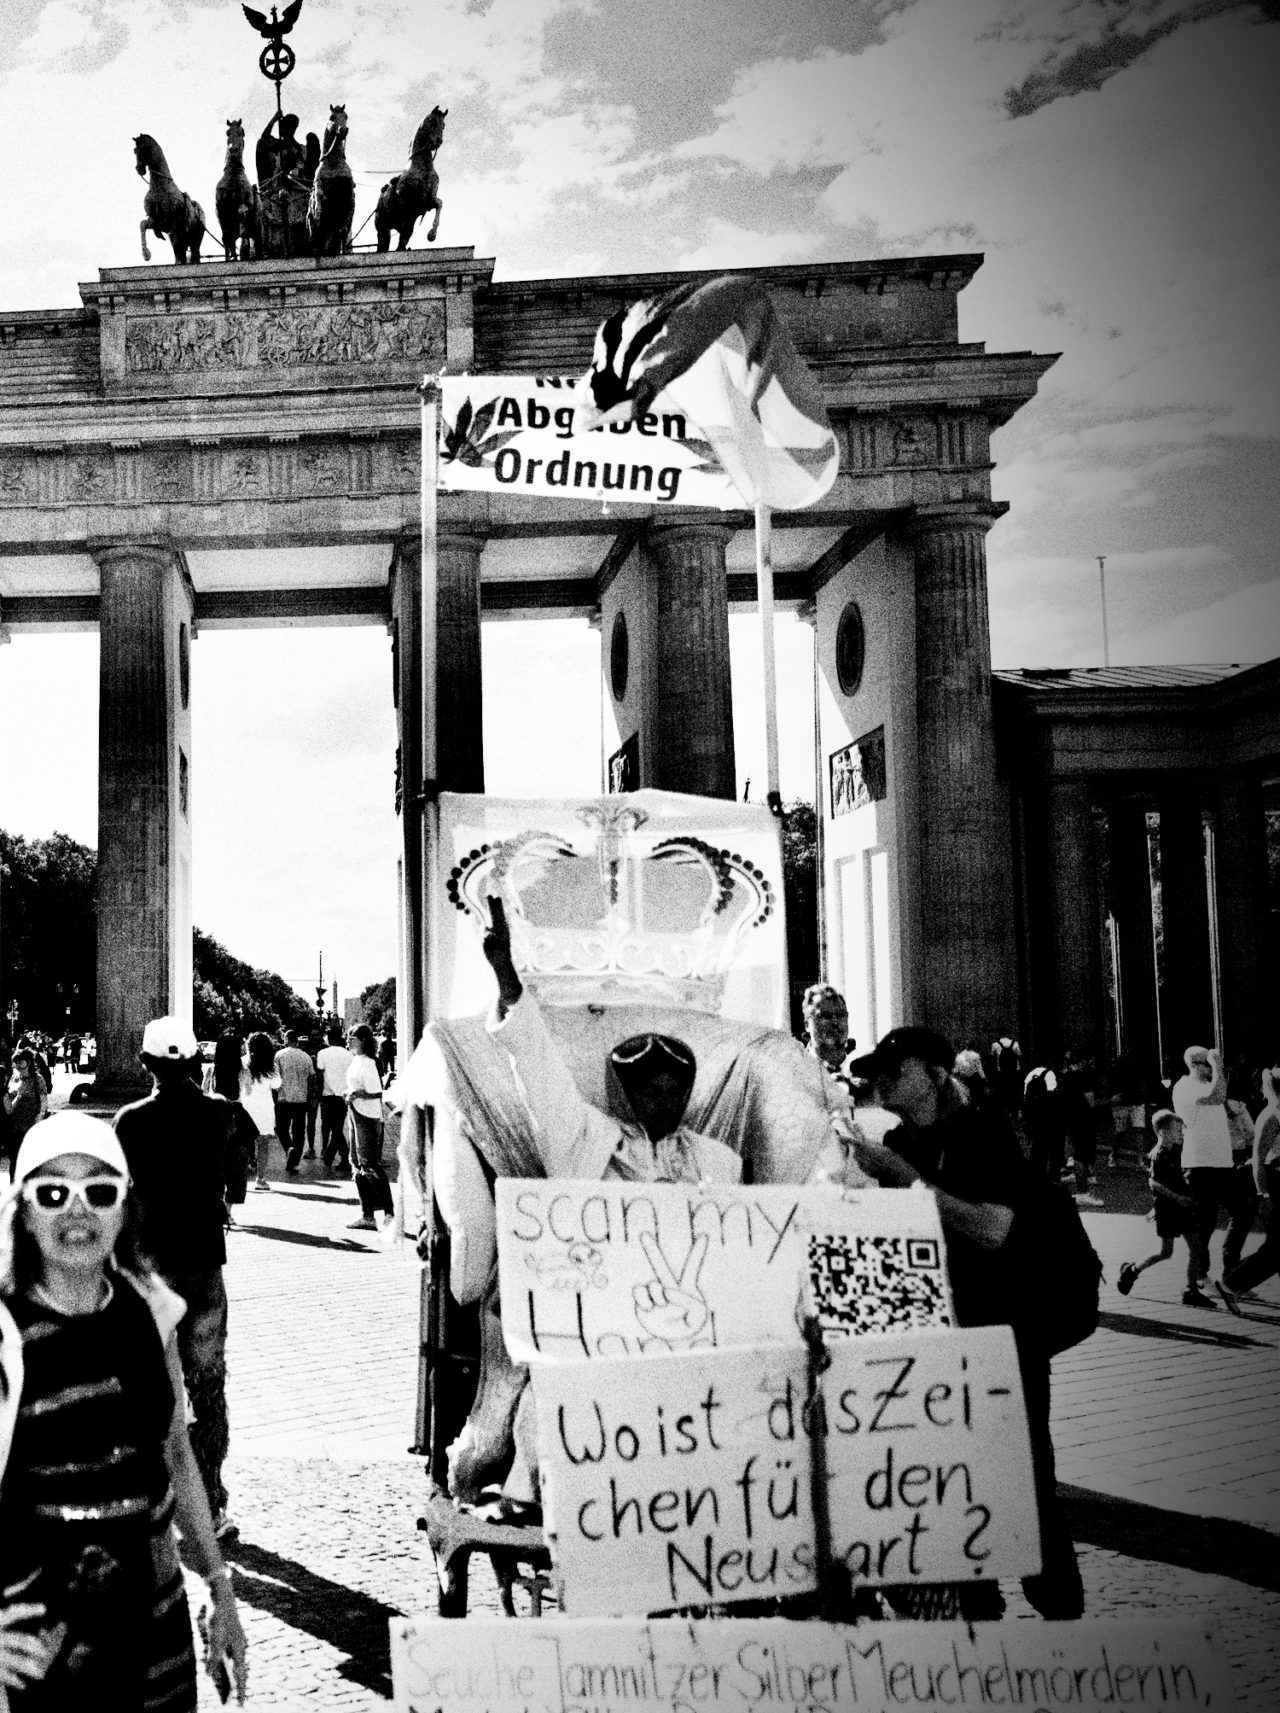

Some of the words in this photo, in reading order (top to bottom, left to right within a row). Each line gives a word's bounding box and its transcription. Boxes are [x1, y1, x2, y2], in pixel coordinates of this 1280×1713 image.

[496, 396, 687, 440] Abgen
[494, 447, 682, 502] Ordnung
[686, 1199, 799, 1265] my
[558, 1400, 640, 1466] Wo
[658, 1385, 721, 1458] ist
[578, 1476, 719, 1541] chen
[737, 1455, 837, 1541] fü
[864, 1446, 973, 1511] den
